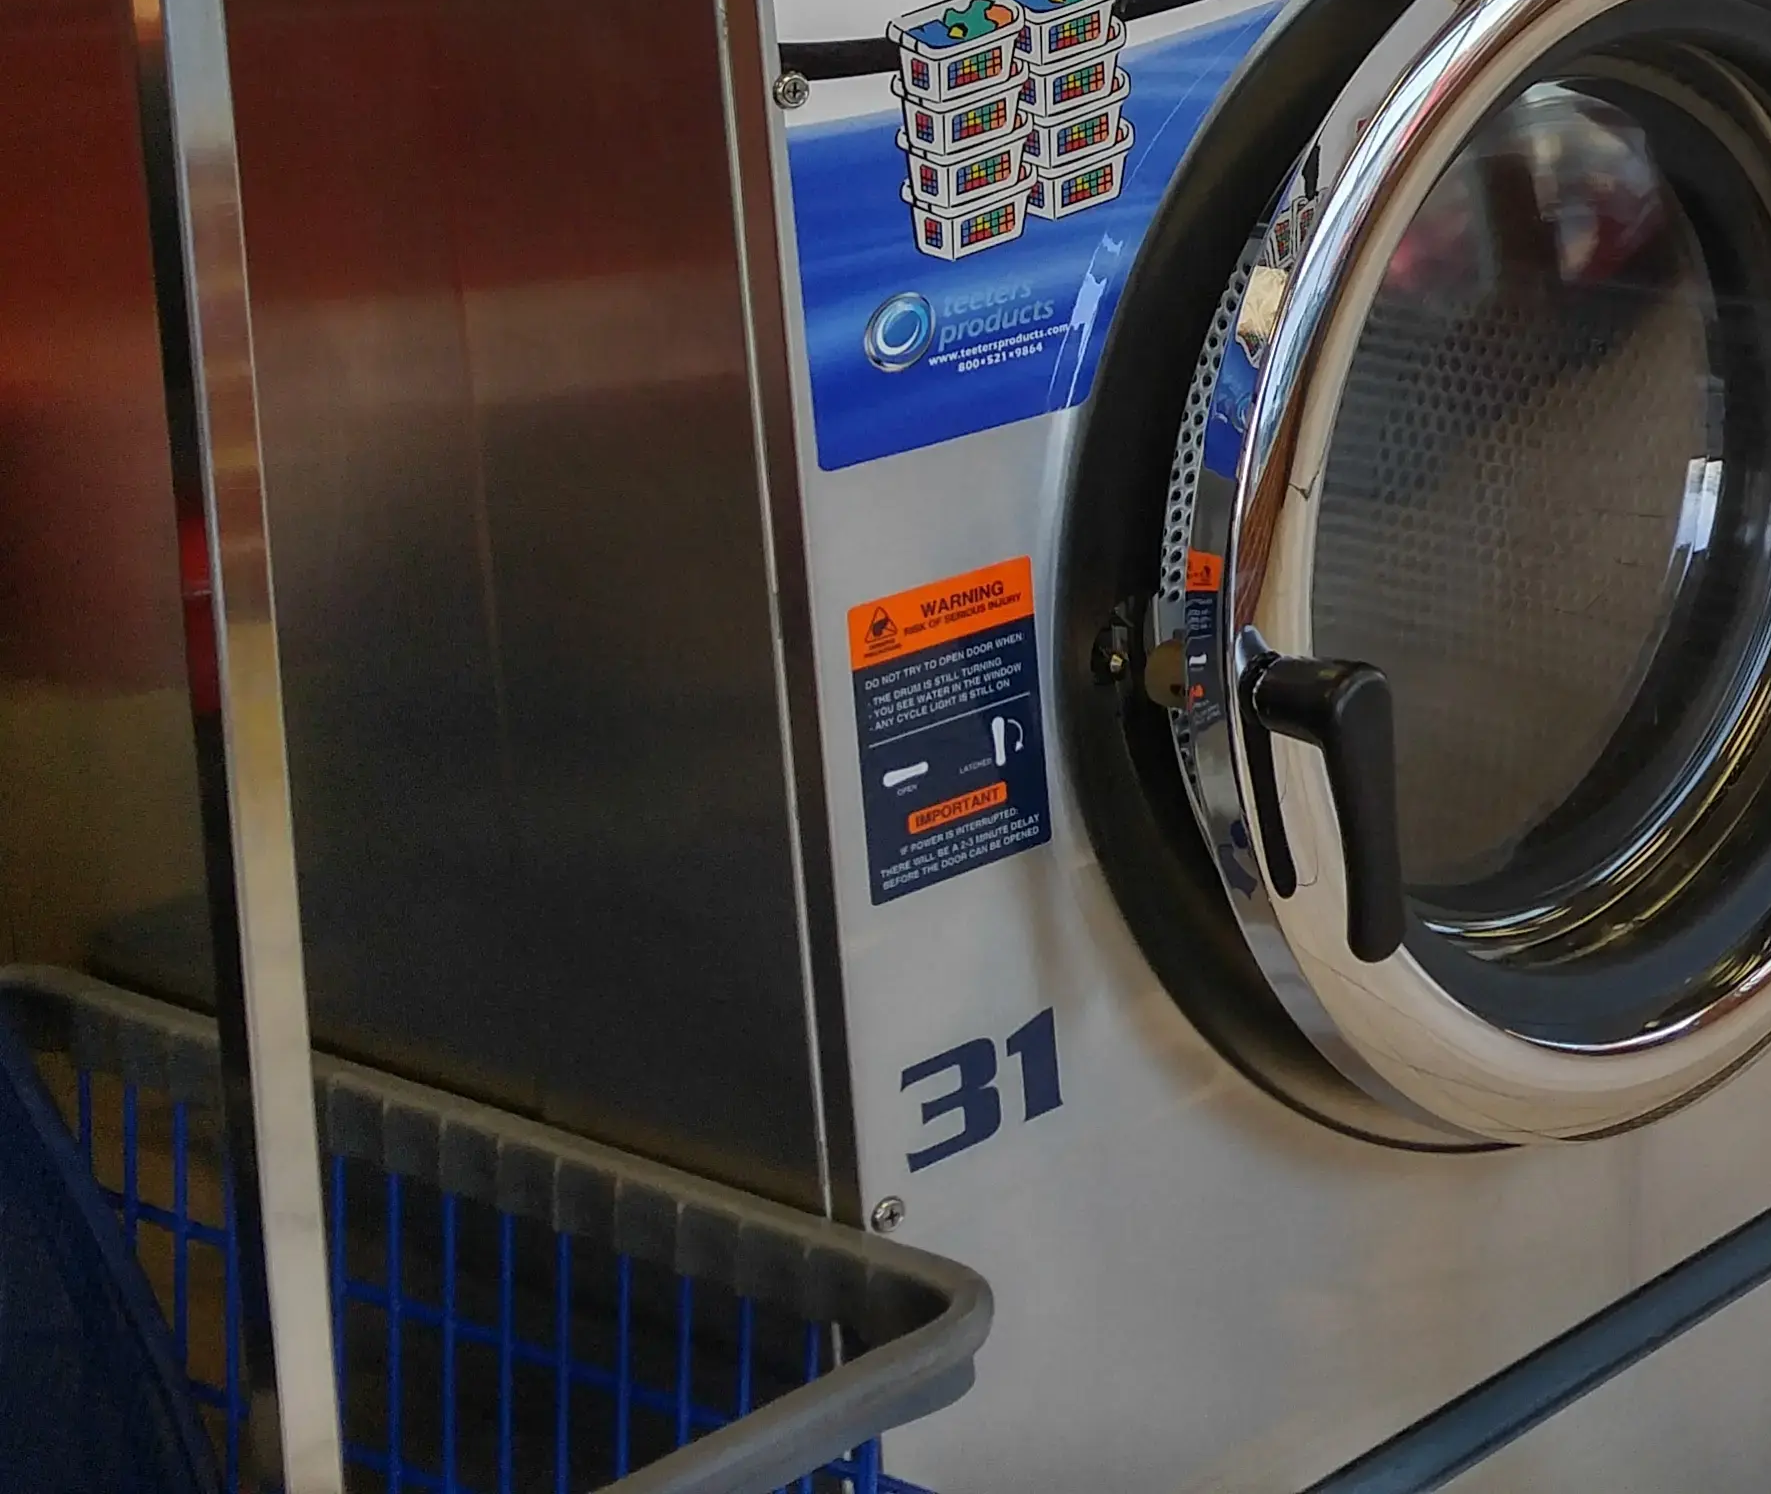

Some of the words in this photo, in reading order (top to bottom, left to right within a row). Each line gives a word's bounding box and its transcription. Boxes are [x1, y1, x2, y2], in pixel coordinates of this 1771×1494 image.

[941, 282, 1032, 318] teeters
[928, 323, 1069, 366] www.teetersproducts.com
[938, 299, 1055, 352] products
[920, 581, 1005, 619] WARNING
[865, 679, 880, 691] DO
[882, 672, 901, 685] NOT
[903, 666, 922, 678] TRY
[924, 661, 937, 671] TO
[939, 653, 965, 668] OPEN
[966, 642, 993, 658] DOOR
[873, 693, 891, 706] THE
[893, 682, 922, 699] DRUM
[923, 680, 932, 691] IS
[934, 672, 959, 687] STILL
[961, 657, 1003, 677] TURNING
[874, 705, 894, 719] YOU
[896, 700, 915, 711] SEE
[917, 687, 950, 703] WATER
[952, 683, 962, 692] IN
[963, 677, 982, 688] THE
[983, 662, 1022, 682] WINDOW
[875, 718, 895, 731] ANY
[897, 708, 928, 724] CYCLE
[930, 698, 956, 712] LIGHT
[959, 693, 968, 703] IS
[970, 686, 996, 700] STILL
[997, 679, 1010, 691] ON
[915, 788, 1000, 828] IMPORTANT
[881, 864, 911, 878] THERE
[913, 854, 935, 867] WILL
[937, 848, 950, 858] BE
[960, 838, 974, 850] 2-3
[975, 828, 1009, 845] MINUTE
[1010, 814, 1040, 830] DELAY
[882, 872, 920, 890] BEFORE
[922, 863, 939, 875] THE
[941, 854, 968, 869] DOOR
[969, 846, 988, 858] CAN
[990, 842, 1001, 851] BE
[1003, 826, 1040, 846] OPENED
[911, 833, 944, 852] POWER
[946, 829, 954, 839] IS
[900, 1006, 1064, 1174] 31
